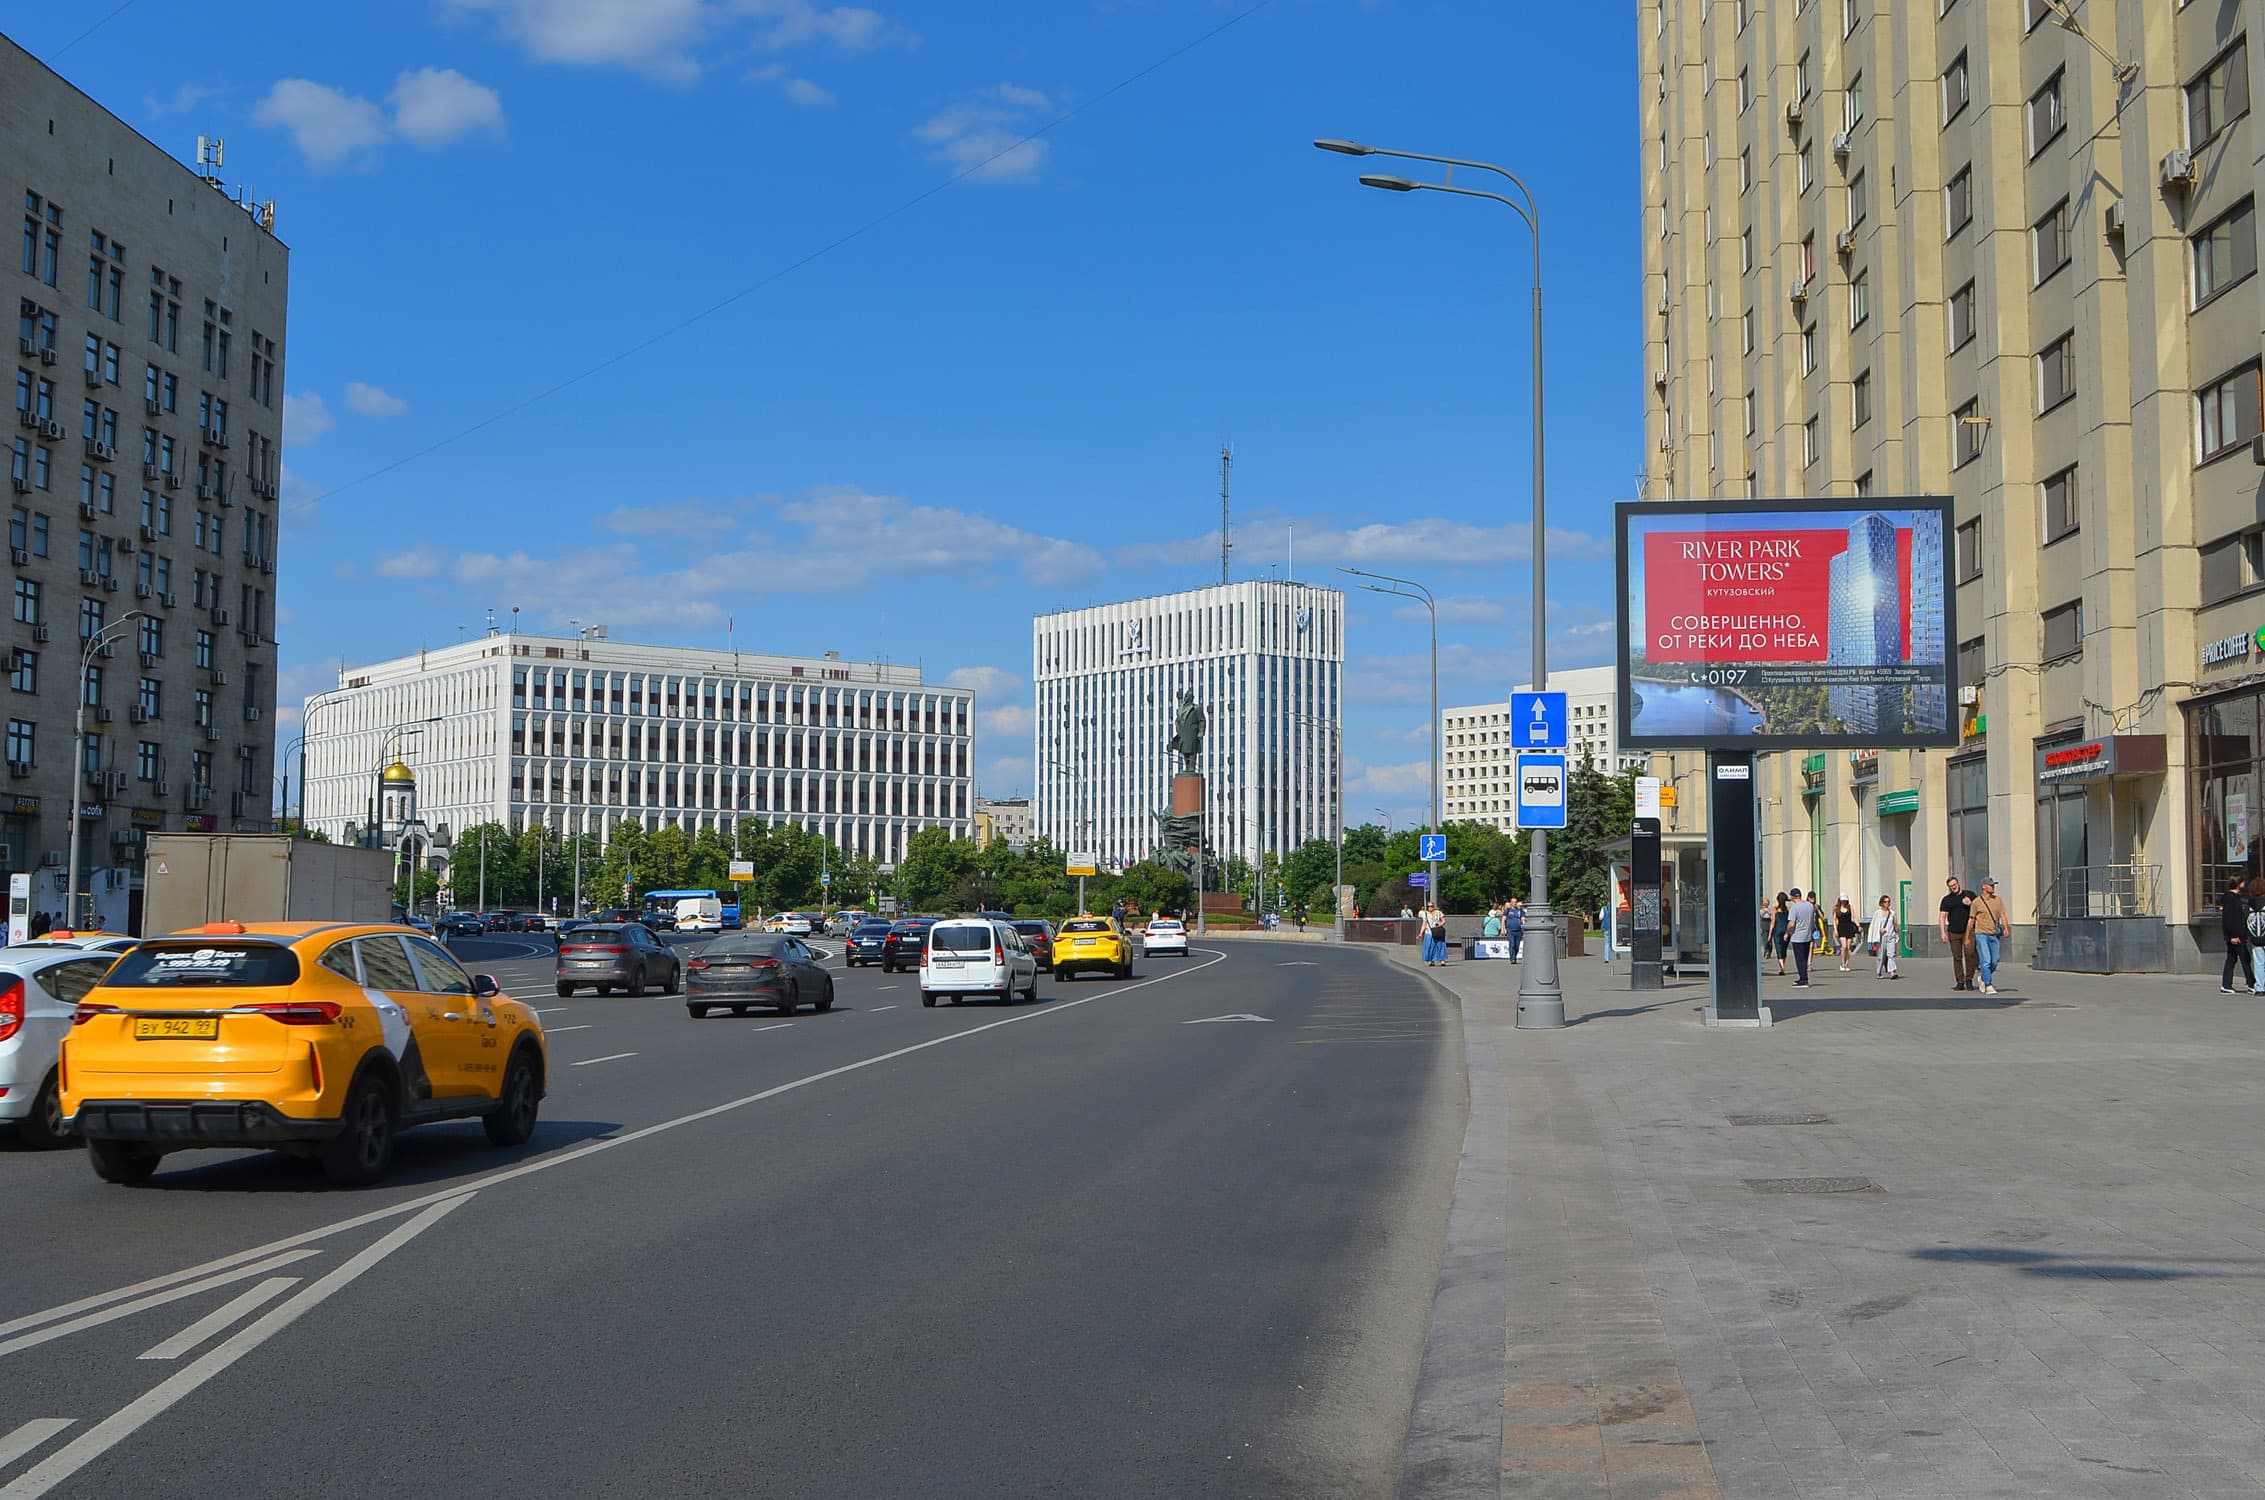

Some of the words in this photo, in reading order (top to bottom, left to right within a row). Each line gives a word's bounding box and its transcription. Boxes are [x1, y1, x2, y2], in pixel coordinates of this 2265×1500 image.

[1672, 540, 1743, 559] RIVER
[1750, 539, 1803, 558] PARK
[1707, 586, 1775, 597] КУТУЗОВСКИЙ
[1671, 614, 1807, 630] СОВЕРШЕННО.
[1658, 634, 1683, 649] ОТ
[1688, 634, 1732, 648] РЕКИ
[1739, 633, 1767, 650] ДО
[1774, 633, 1820, 648] НЕБА
[2205, 640, 2224, 664] PRICE
[2223, 632, 2247, 658] COFFEE
[163, 1021, 189, 1034] 942
[195, 1020, 210, 1031] 99
